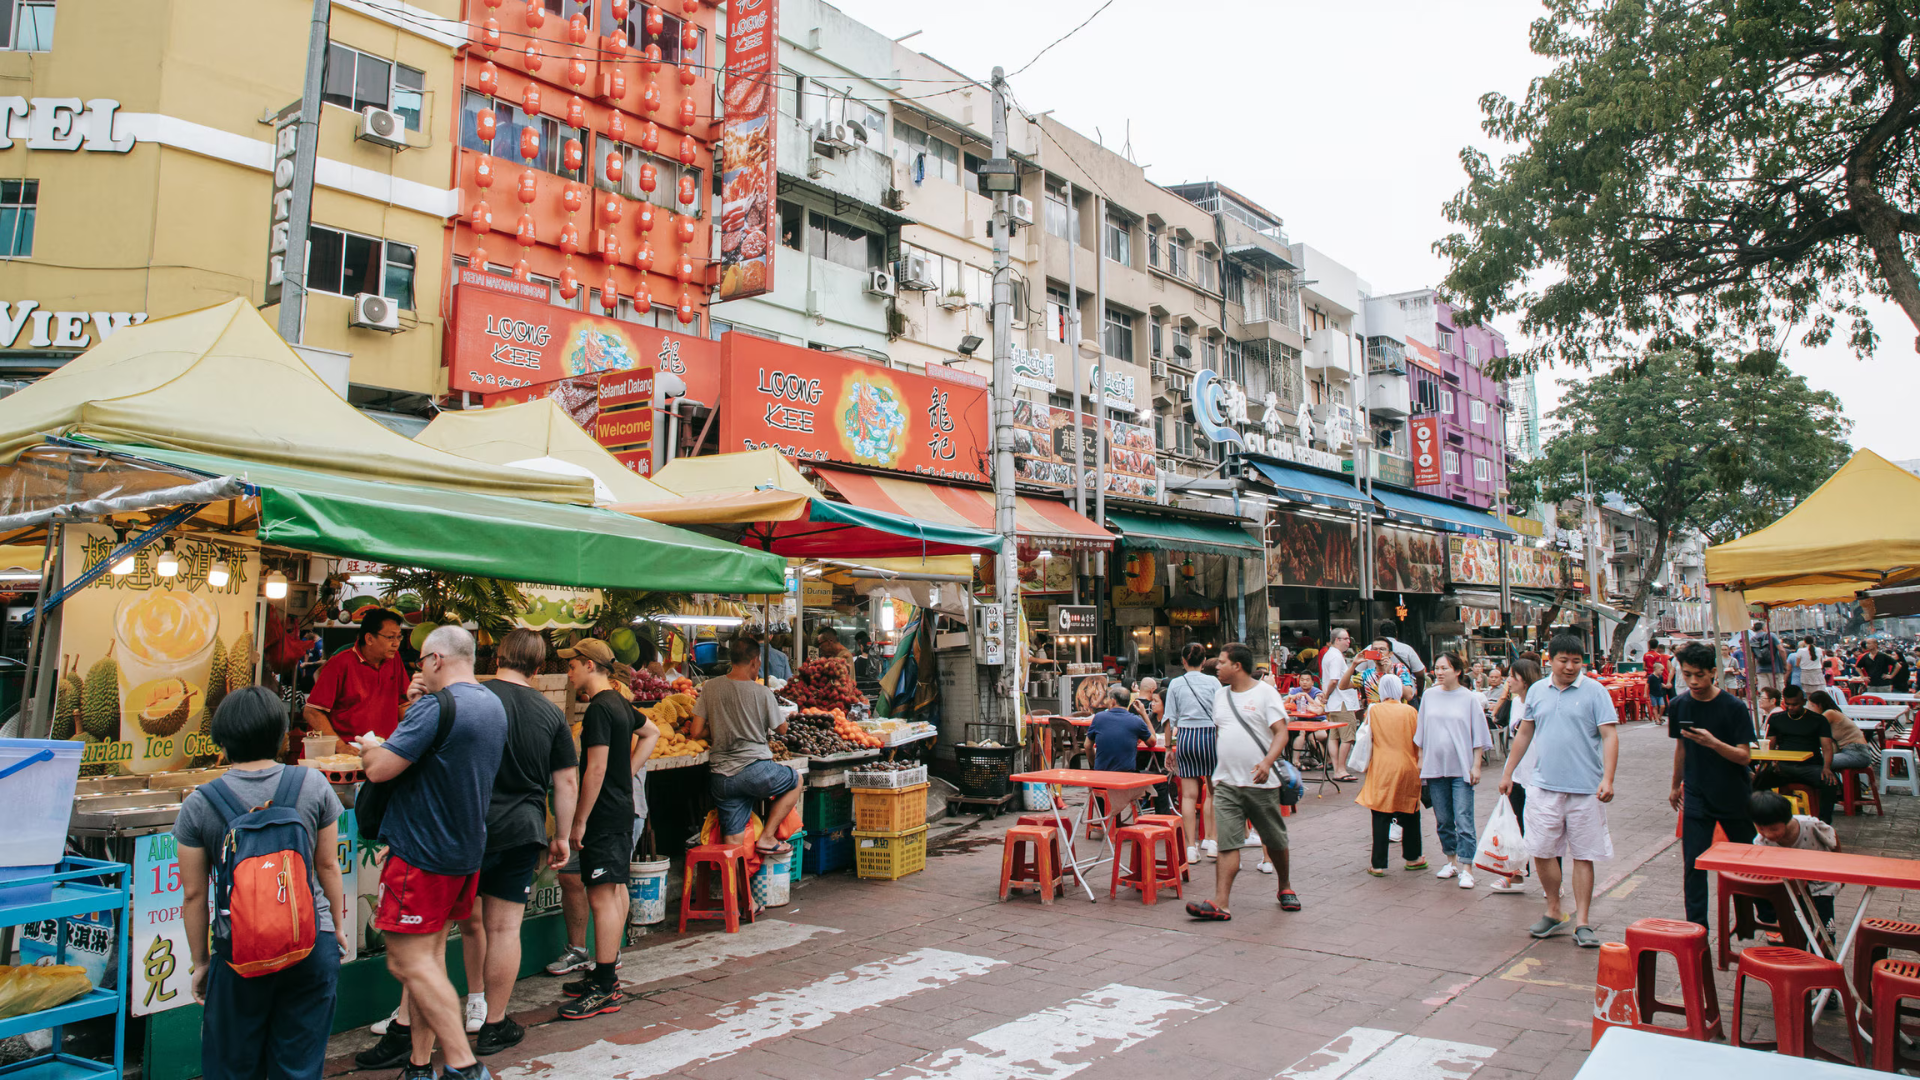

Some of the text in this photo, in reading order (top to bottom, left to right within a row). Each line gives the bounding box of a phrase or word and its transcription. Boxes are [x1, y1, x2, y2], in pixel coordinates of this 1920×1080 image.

[731, 10, 768, 37] LOONG
[734, 31, 764, 53] KEE
[270, 125, 297, 286] HOTEL
[463, 270, 546, 300] KEDAI MAKANAN RINGAN
[485, 315, 550, 346] LOONG
[491, 343, 541, 370] KEE
[600, 378, 653, 399] Selamat Datang
[757, 368, 823, 404] LOONG
[599, 420, 651, 438] Welcome
[763, 403, 814, 433] KEE
[927, 386, 956, 461] 龍記
[796, 447, 813, 459] Love
[1417, 427, 1433, 467] OYO
[807, 587, 831, 595] Durian
[81, 733, 222, 763] urian Ice Crea
[24, 920, 109, 953] 椰子淇淋
